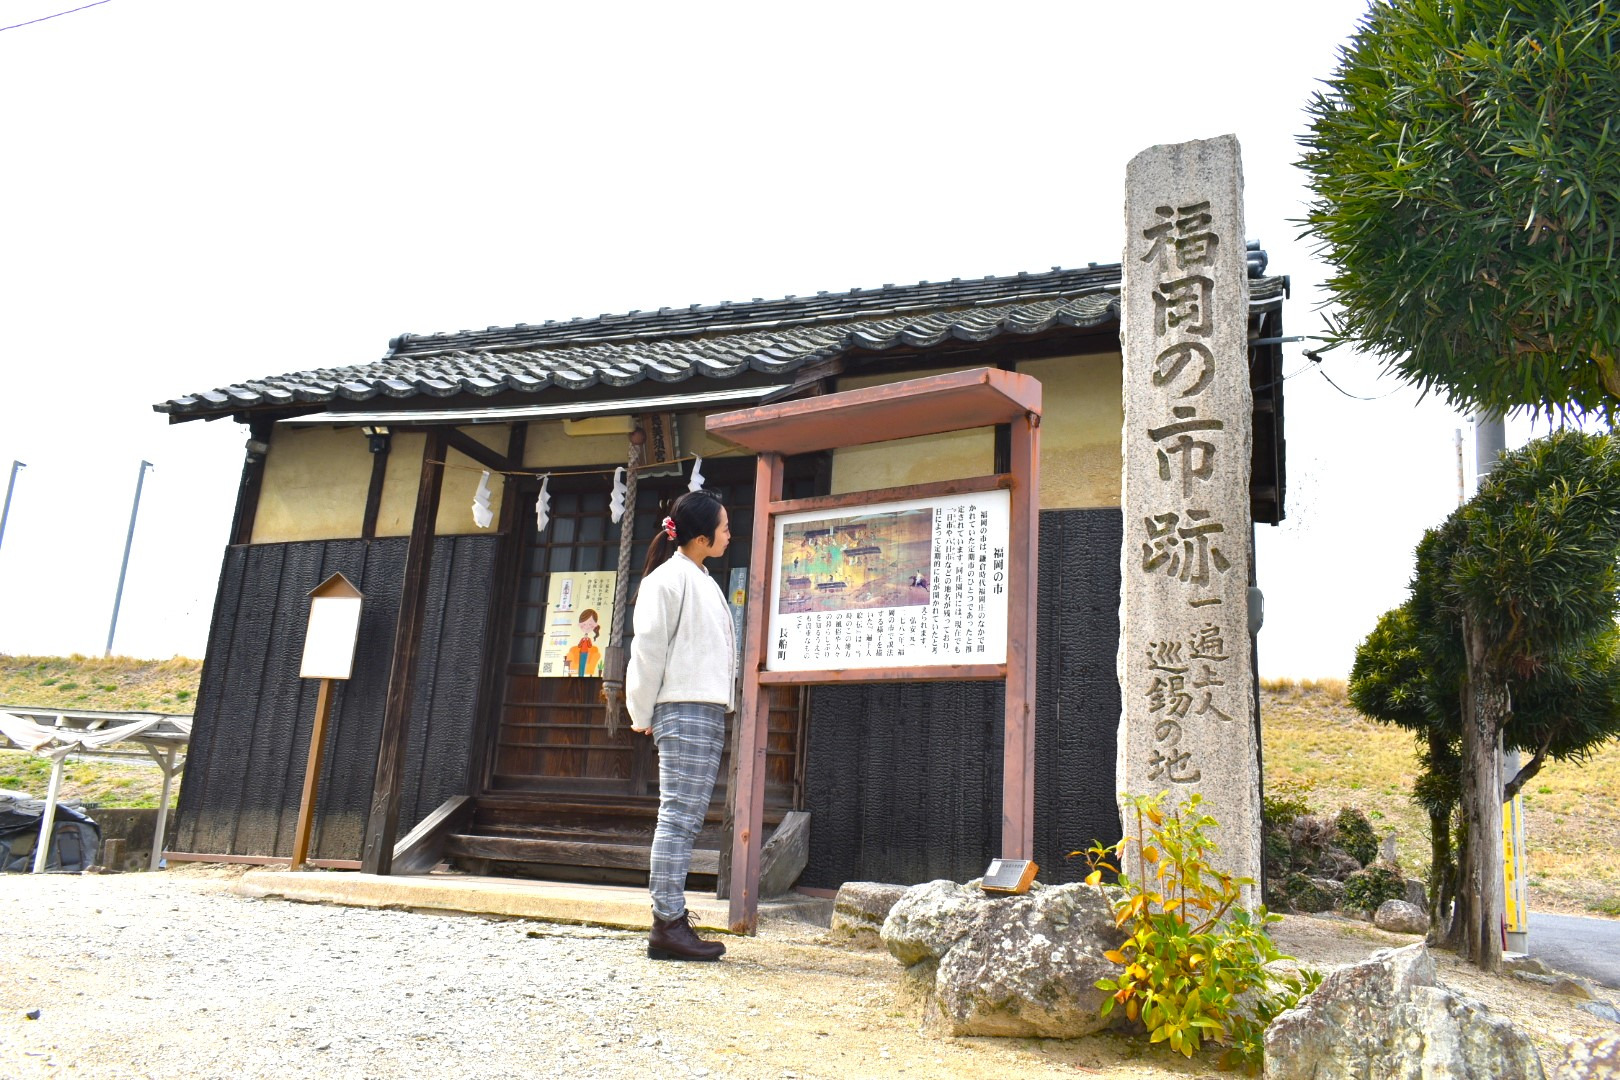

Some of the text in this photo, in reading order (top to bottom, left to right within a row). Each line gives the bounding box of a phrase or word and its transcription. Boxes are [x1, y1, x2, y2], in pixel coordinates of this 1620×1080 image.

[1141, 201, 1231, 588] 福岡の市跡
[965, 504, 977, 654] かれていた定期市のひとつであったと推
[993, 547, 1004, 595] 福岡の市
[777, 628, 789, 661] 長船町
[814, 614, 822, 659] を知るうえで
[835, 613, 843, 658] の風俗や人々
[845, 612, 853, 658] 時のこの地方
[875, 610, 885, 657] する様子を描
[886, 608, 896, 657] 岡の市で説法
[919, 606, 928, 648] えられます。
[1186, 597, 1234, 724] 一遍上人
[1145, 639, 1201, 784] 巡錫の地
